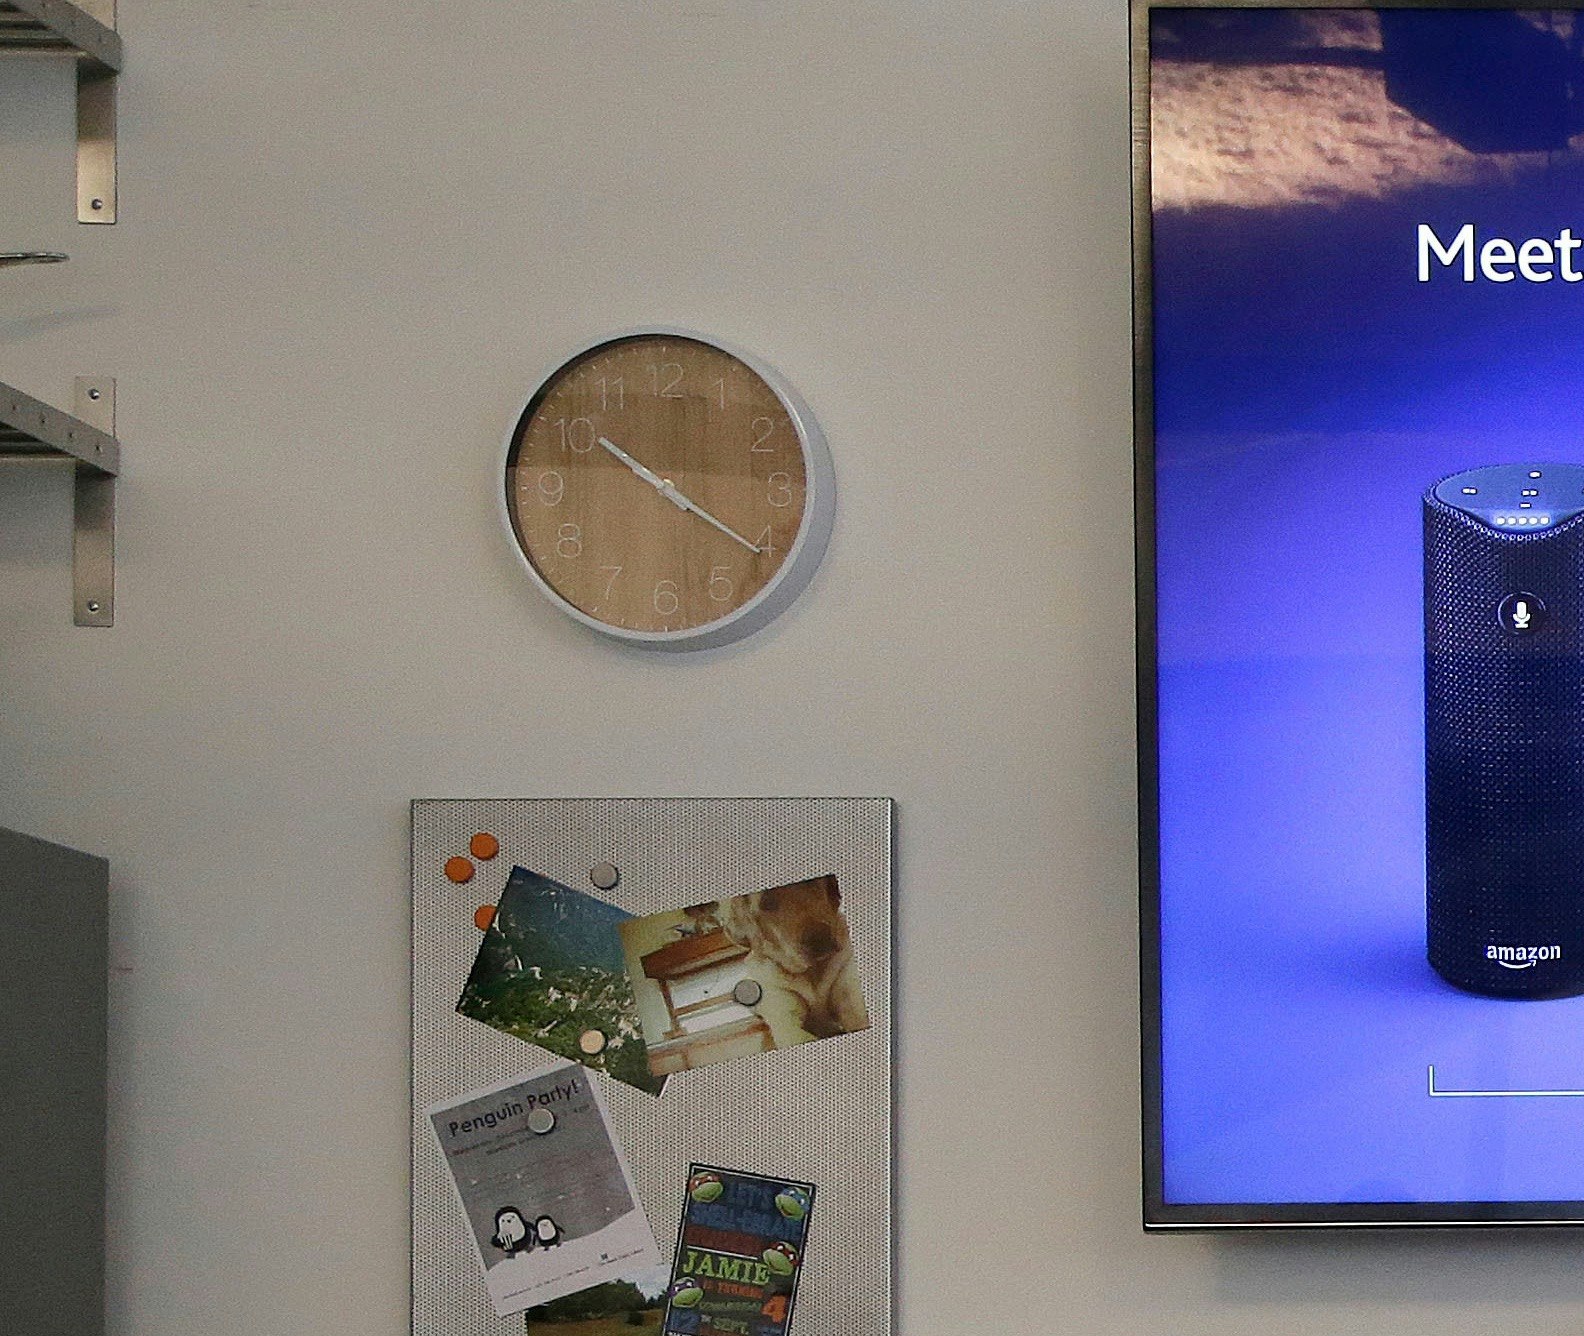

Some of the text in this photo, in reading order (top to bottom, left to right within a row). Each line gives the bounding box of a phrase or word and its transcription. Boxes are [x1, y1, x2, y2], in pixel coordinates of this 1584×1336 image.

[1417, 223, 1584, 282] Meet
[598, 377, 626, 411] 11
[647, 363, 684, 398] 12
[714, 377, 726, 410] 1
[554, 417, 597, 453] 10
[750, 416, 776, 453] 2
[538, 471, 564, 507] 9
[767, 471, 793, 508] 3
[556, 523, 583, 559] 8
[751, 525, 777, 558] 4
[600, 565, 624, 601] 7
[653, 580, 680, 615] 6
[708, 566, 733, 602] 5
[1486, 945, 1561, 963] amazon
[448, 1101, 524, 1138] Penguin
[682, 1250, 771, 1286] JAMIE
[761, 1295, 788, 1324] 4
